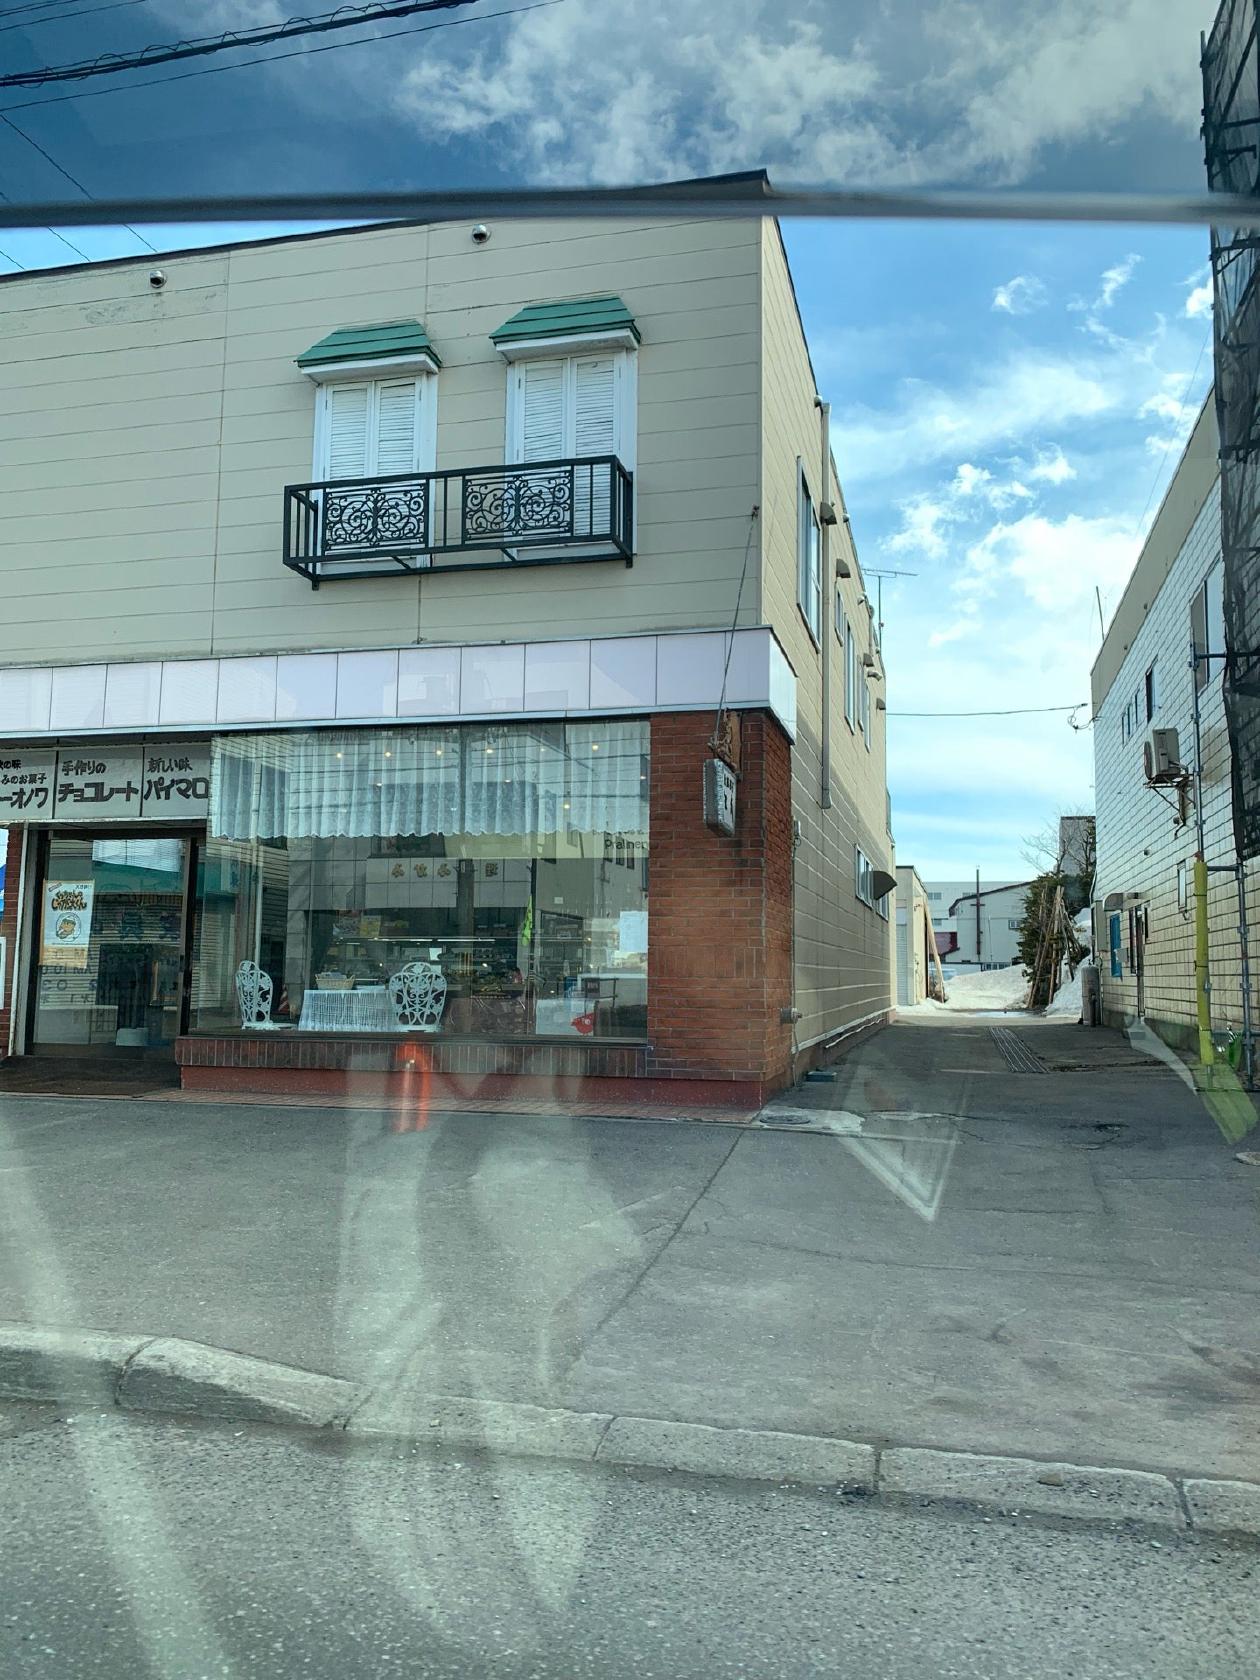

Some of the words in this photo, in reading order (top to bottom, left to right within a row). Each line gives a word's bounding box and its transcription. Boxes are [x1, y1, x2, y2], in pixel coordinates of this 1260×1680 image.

[61, 760, 107, 776] 手作りの
[147, 756, 193, 773] 新しい味
[58, 780, 139, 802] チョコレート
